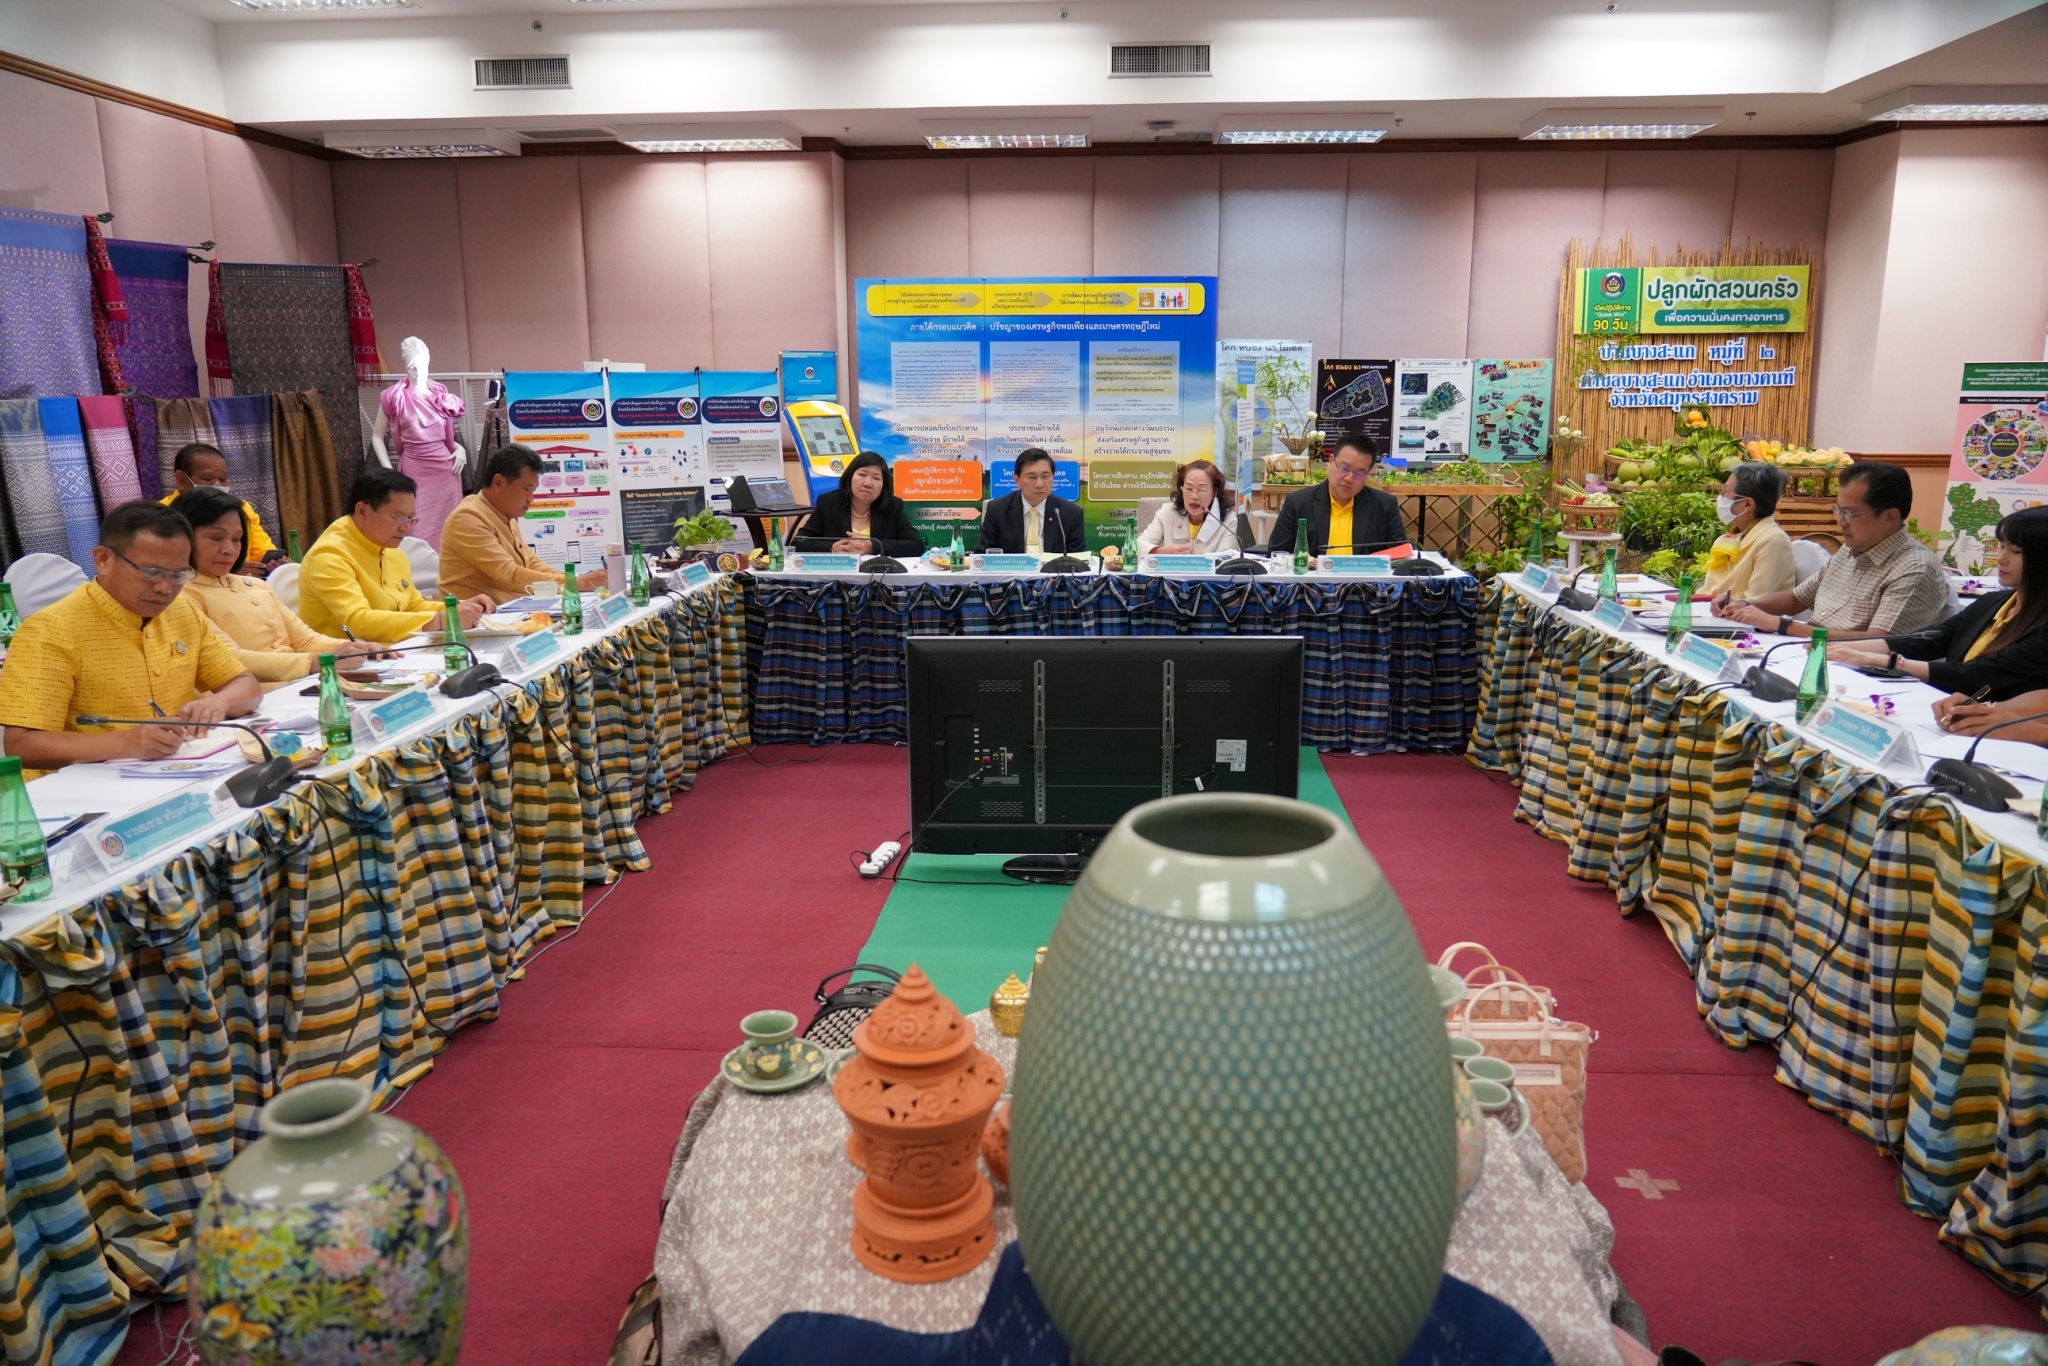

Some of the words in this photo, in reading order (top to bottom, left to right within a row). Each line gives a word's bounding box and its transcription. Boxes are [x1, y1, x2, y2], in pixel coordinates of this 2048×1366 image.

[1646, 275, 1800, 308] ปลูกผักสวนครัว
[1664, 309, 1785, 322] เพื่อความมั่นคงทางอาหาร
[910, 322, 976, 331] ภายใต้กรอบแนวคิด
[990, 321, 1160, 332] ปรัชญาของเศรษฐกิจพอเพียงและเกษตรทฤษฎีใหม่
[1593, 319, 1609, 330] 90
[1612, 318, 1628, 330] วัน
[1220, 342, 1236, 352] โคก
[1278, 342, 1303, 352] โมเดล
[1709, 337, 1745, 366] หมู่ที่
[1759, 345, 1774, 360] ๒
[1610, 388, 1760, 412] จังหวัดสมุทรสงคราม
[1003, 434, 1047, 442] เกิดความมั่นคง
[1049, 434, 1065, 442] ยั่งยืน
[1097, 436, 1169, 445] ส่งเสริมเศรษฐกิจฐานราก
[914, 446, 962, 454] บริหารจัดการหนี้
[1094, 447, 1172, 456] สร้างรายได้กระจายสู่ชุมชน
[914, 477, 962, 487] ปลูกผักสวนครัว
[917, 509, 961, 517] ระดับครัวเรือน
[124, 816, 163, 839] นายสมชาย
